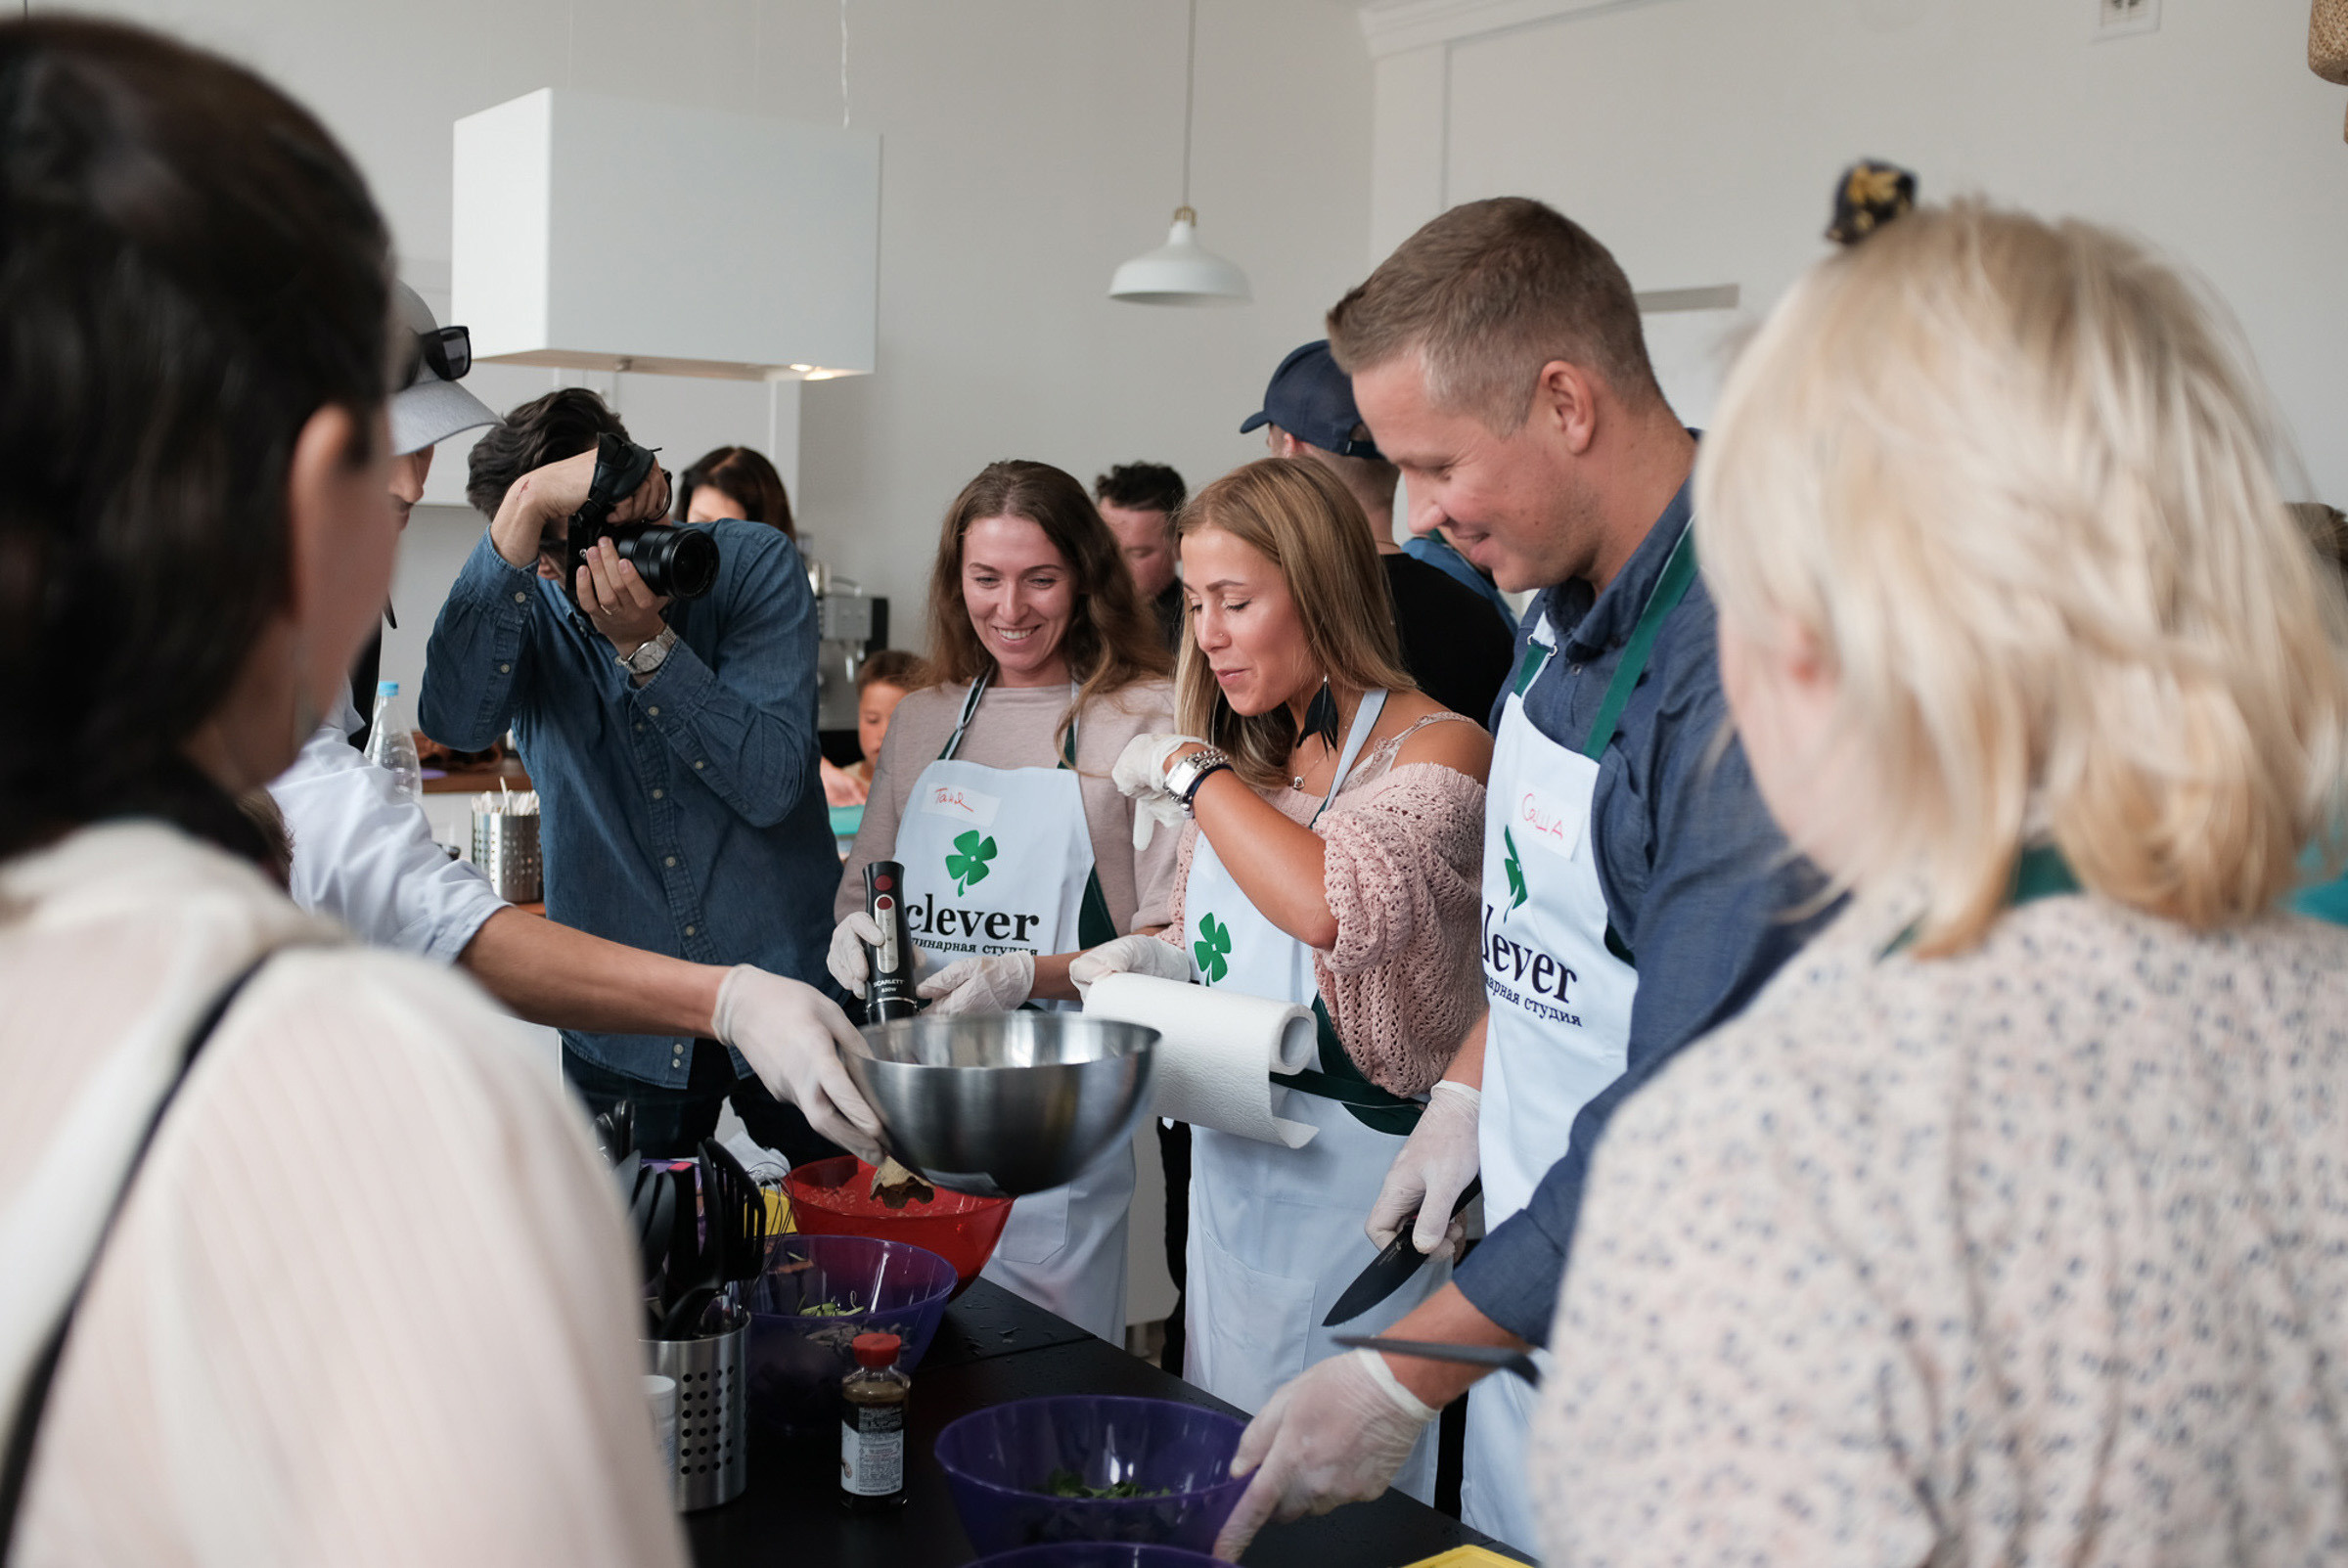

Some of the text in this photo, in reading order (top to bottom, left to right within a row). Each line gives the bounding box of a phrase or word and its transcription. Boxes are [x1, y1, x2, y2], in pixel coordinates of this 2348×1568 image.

[906, 893, 1040, 942] clever
[911, 937, 976, 953] линарная
[1482, 904, 1577, 1004] lever
[1485, 975, 1583, 1027] арная студия
